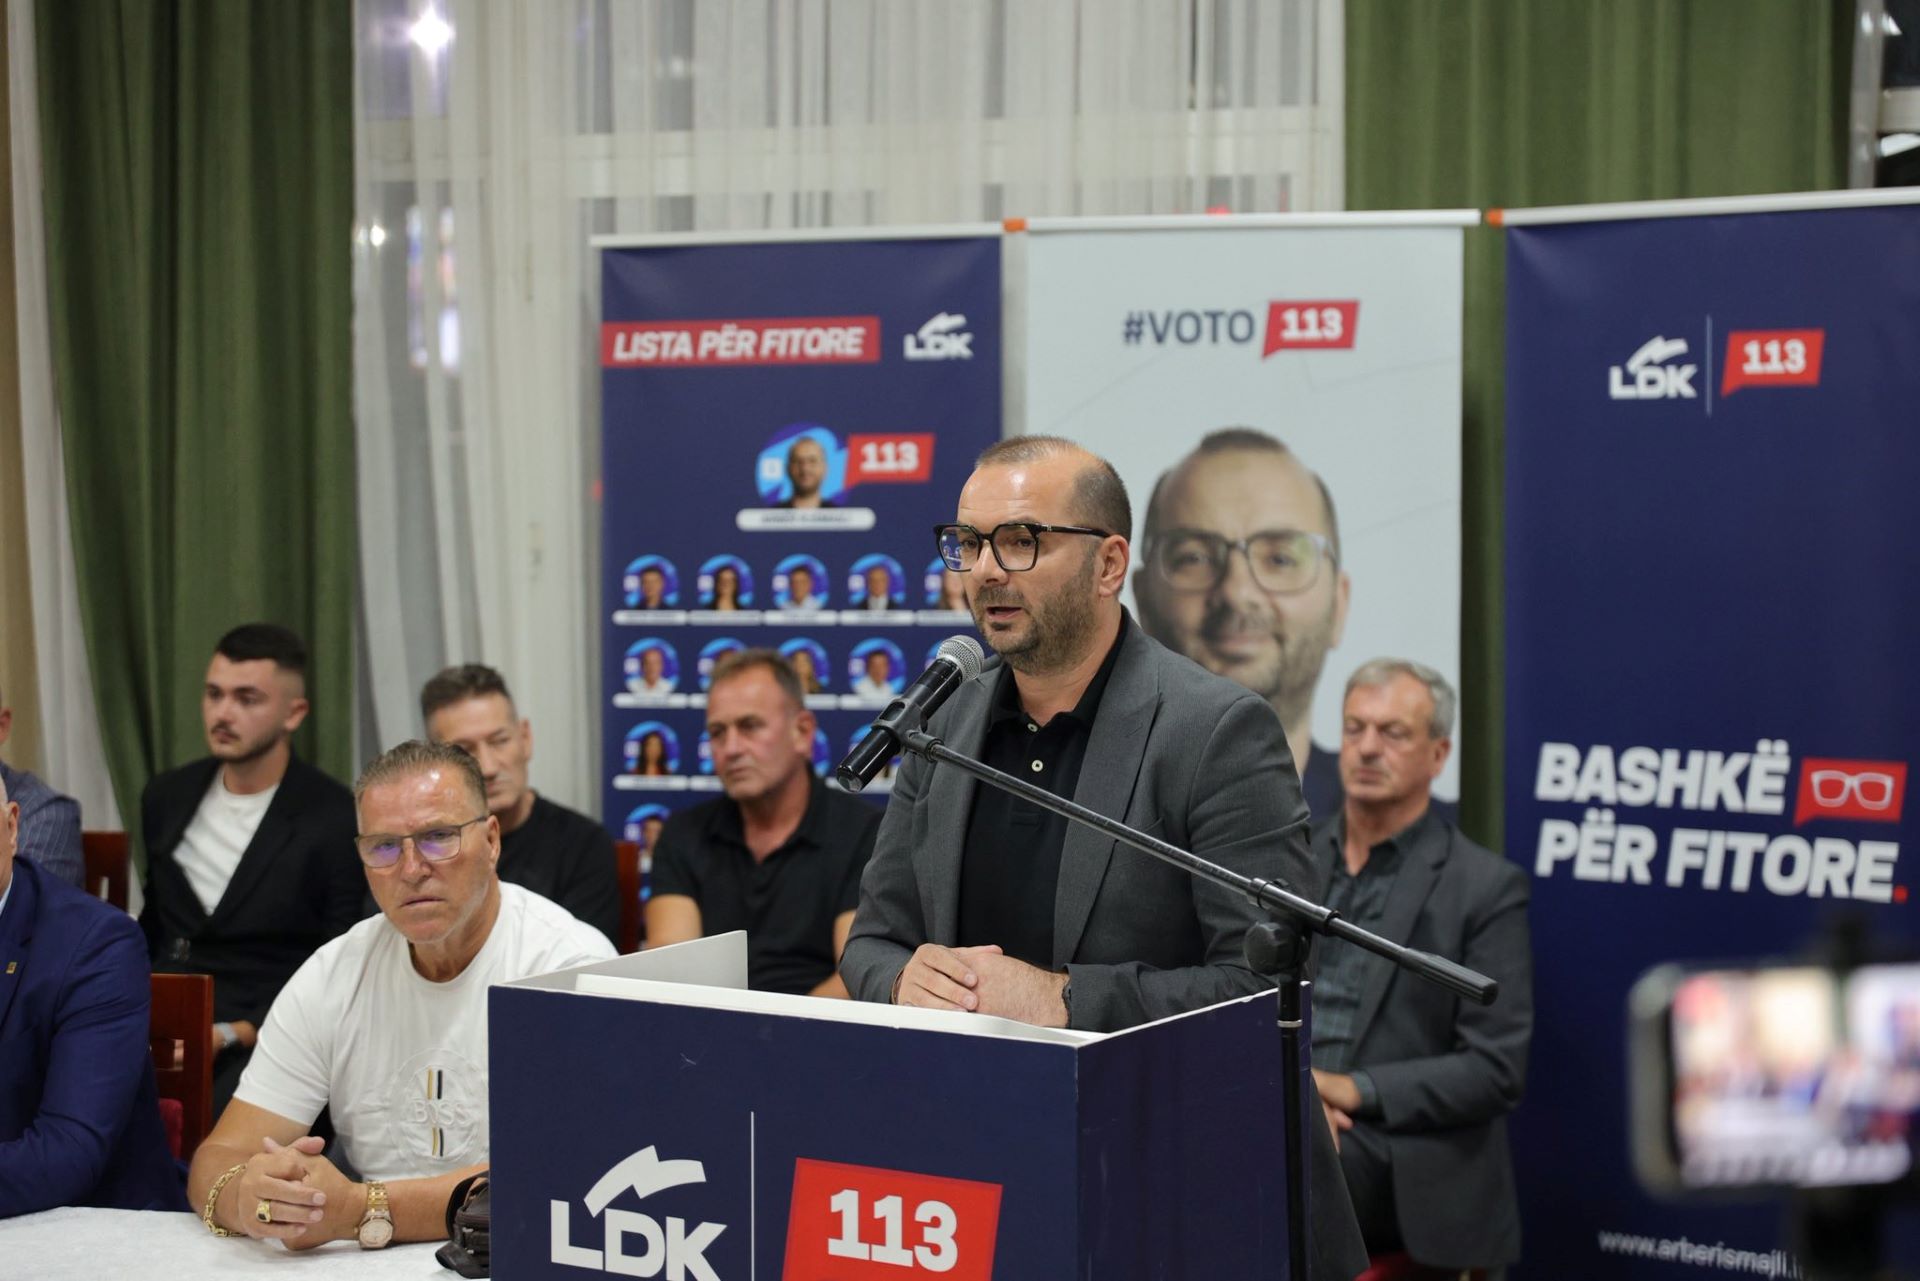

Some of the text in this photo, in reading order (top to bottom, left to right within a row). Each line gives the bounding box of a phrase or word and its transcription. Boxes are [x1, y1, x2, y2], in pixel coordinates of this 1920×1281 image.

[613, 324, 867, 361] LISTA PËR FITORE
[1123, 309, 1256, 345] #VOTO
[1280, 306, 1344, 342] 113
[904, 332, 974, 361] LDK
[1742, 338, 1808, 375] 113
[1608, 362, 1699, 400] LDK
[860, 441, 921, 473] 113
[1534, 738, 1792, 816] BASHKË
[1534, 807, 1659, 885] PËR
[551, 1199, 728, 1281] LDK
[828, 1188, 959, 1273] 113
